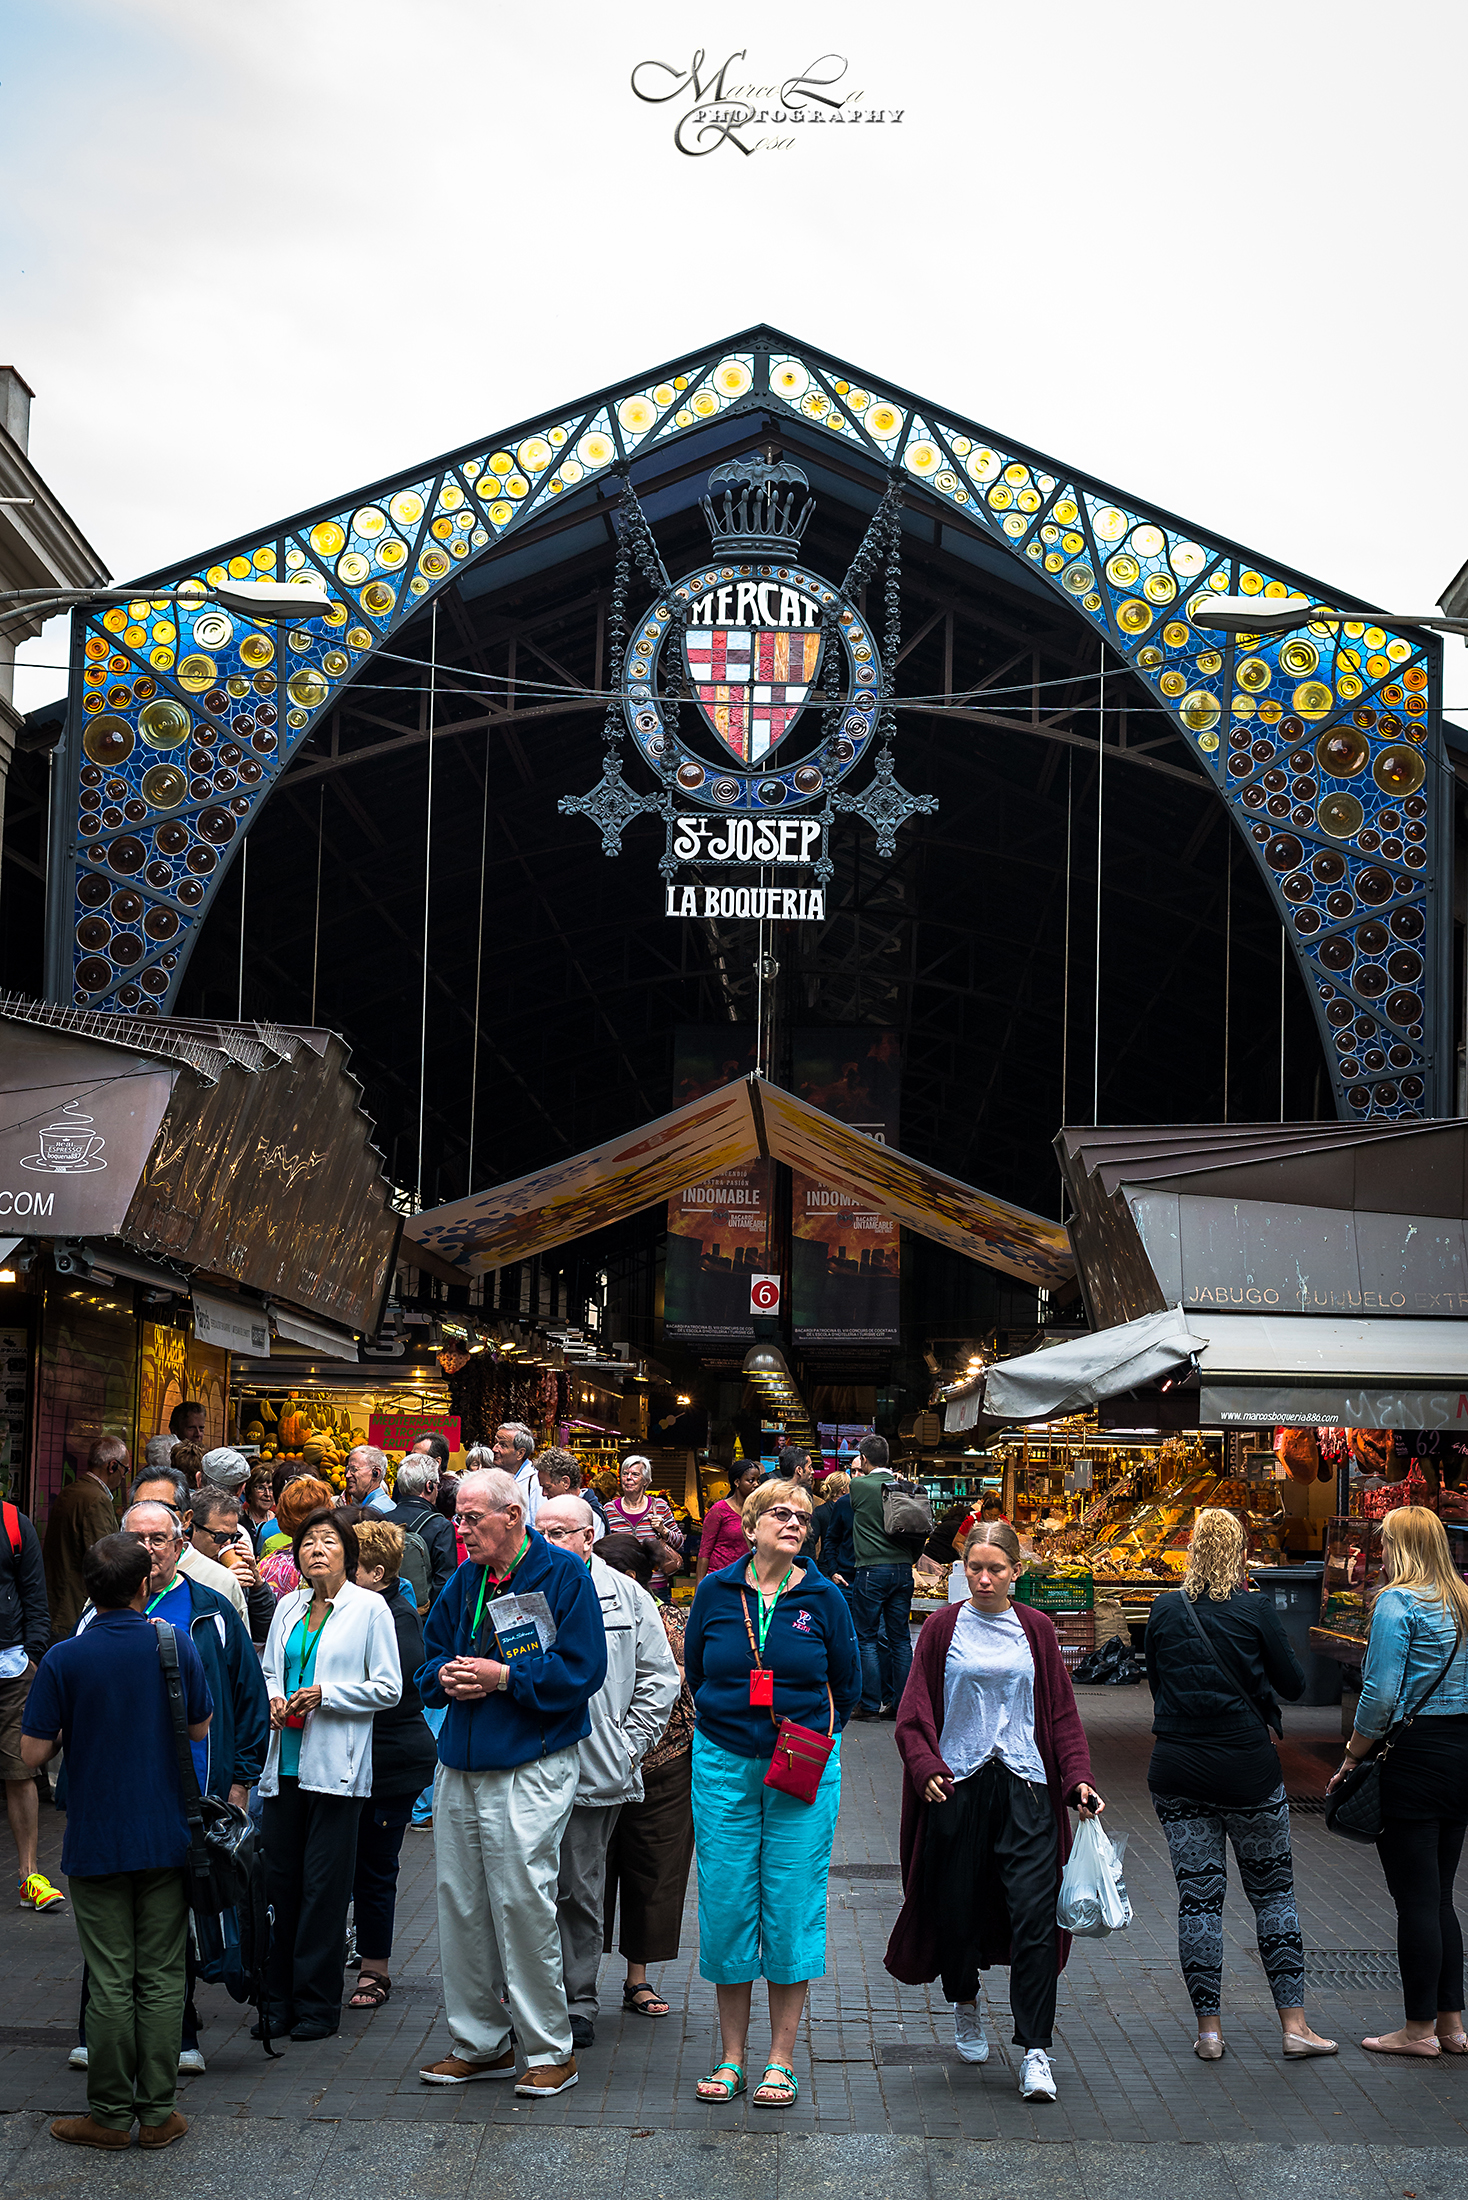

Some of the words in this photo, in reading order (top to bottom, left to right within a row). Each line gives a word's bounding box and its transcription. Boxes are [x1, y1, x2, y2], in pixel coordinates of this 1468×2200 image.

[691, 582, 819, 627] MERCAT
[707, 820, 821, 861] JOSEP
[666, 886, 697, 917] LA
[703, 887, 825, 919] BOQUERIA
[0, 1191, 55, 1216] COM
[682, 1188, 760, 1205] INDOMABLE
[759, 1284, 771, 1303] 6
[1189, 1286, 1280, 1304] JABUGO
[372, 1415, 459, 1427] MEDITERRANEAN
[1220, 1410, 1339, 1423] www.marcosboqueria886.com
[383, 1427, 392, 1437] &
[382, 1438, 411, 1448] FRUIT
[505, 1641, 539, 1659] SPAIN
